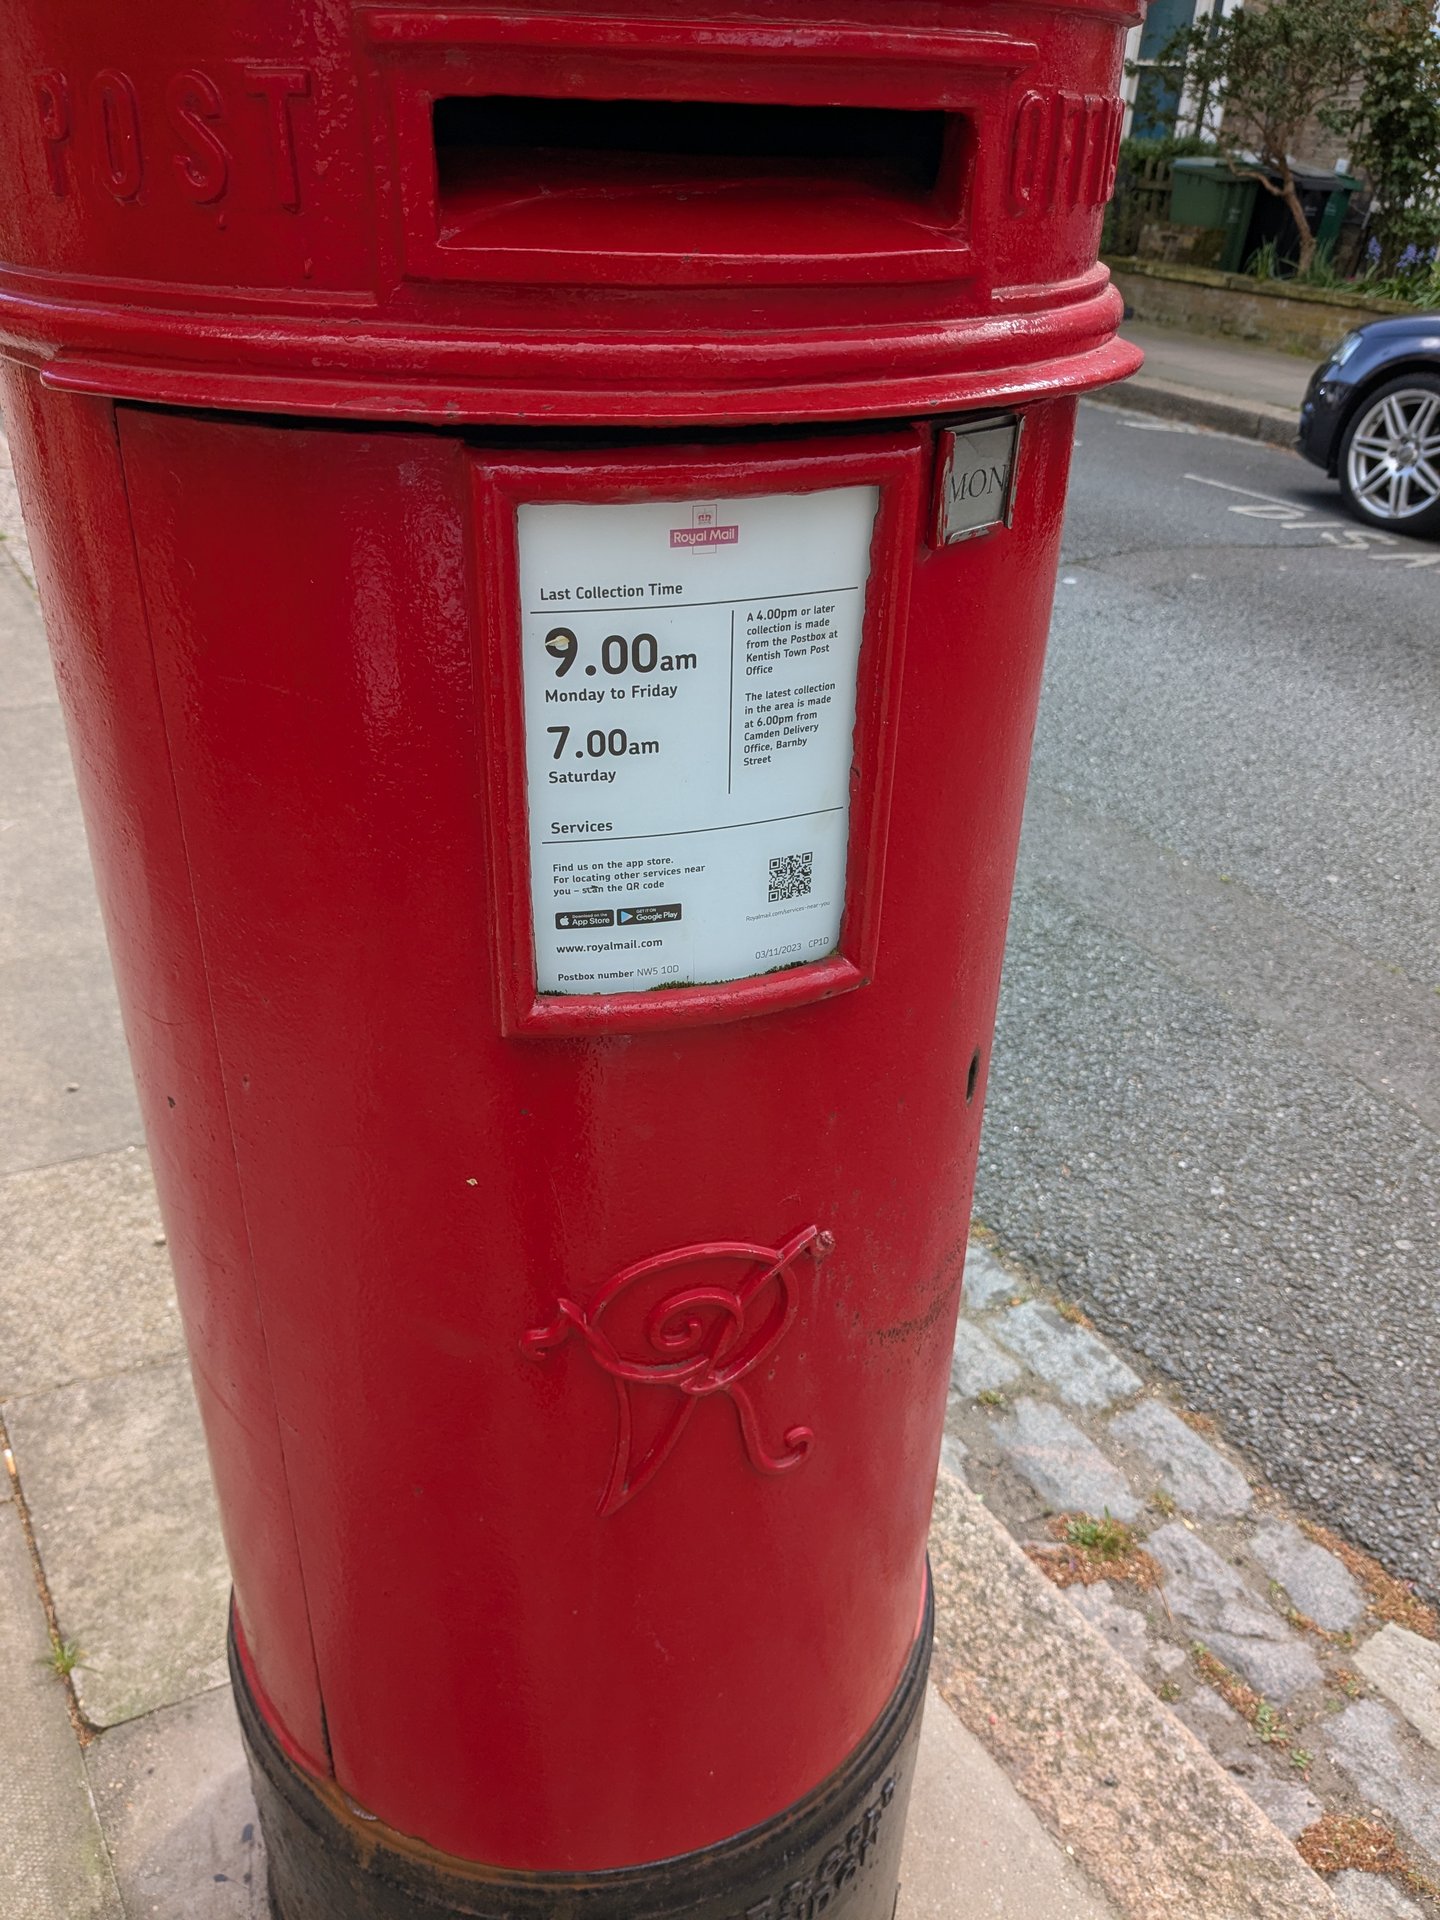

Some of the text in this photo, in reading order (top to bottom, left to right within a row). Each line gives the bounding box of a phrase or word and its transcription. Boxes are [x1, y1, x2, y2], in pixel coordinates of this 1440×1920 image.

[32, 66, 313, 216] POST
[949, 464, 1010, 504] MON
[673, 527, 735, 545] Royal Mail
[540, 583, 683, 601] Last Collection Time
[747, 605, 835, 622] A 4.00pm or later
[747, 618, 830, 635] collection is made
[746, 630, 838, 649] from the Postbox at
[545, 627, 697, 678] 9.00am
[746, 644, 830, 662] Kentish Town Post
[746, 665, 773, 675] Office
[545, 684, 678, 703] Monday to Friday
[745, 682, 836, 702] The latest collection
[744, 695, 832, 715] in the area is made
[744, 711, 818, 728] at 6.00pm from
[744, 724, 819, 741] Camden Delivery
[547, 726, 659, 759] 7.00am
[743, 737, 808, 754] Office, Barnby
[743, 755, 772, 766] Street
[548, 769, 616, 784] Saturday
[551, 820, 613, 834] Services
[553, 863, 574, 872] Find
[607, 860, 623, 869] the
[626, 859, 644, 868] app
[647, 856, 674, 866] store.
[553, 865, 706, 884] For locating other services near
[553, 887, 571, 897] you
[582, 886, 604, 894] scan
[607, 883, 623, 892] the
[626, 881, 640, 891] QR
[643, 880, 665, 889] code
[572, 917, 610, 927] App Store
[636, 911, 678, 922] Google Play
[556, 939, 663, 953] www.royalmail.com
[755, 942, 802, 960] 03/11/2023
[558, 972, 595, 981] Postbox
[597, 970, 634, 979] number
[637, 966, 658, 976] NW5
